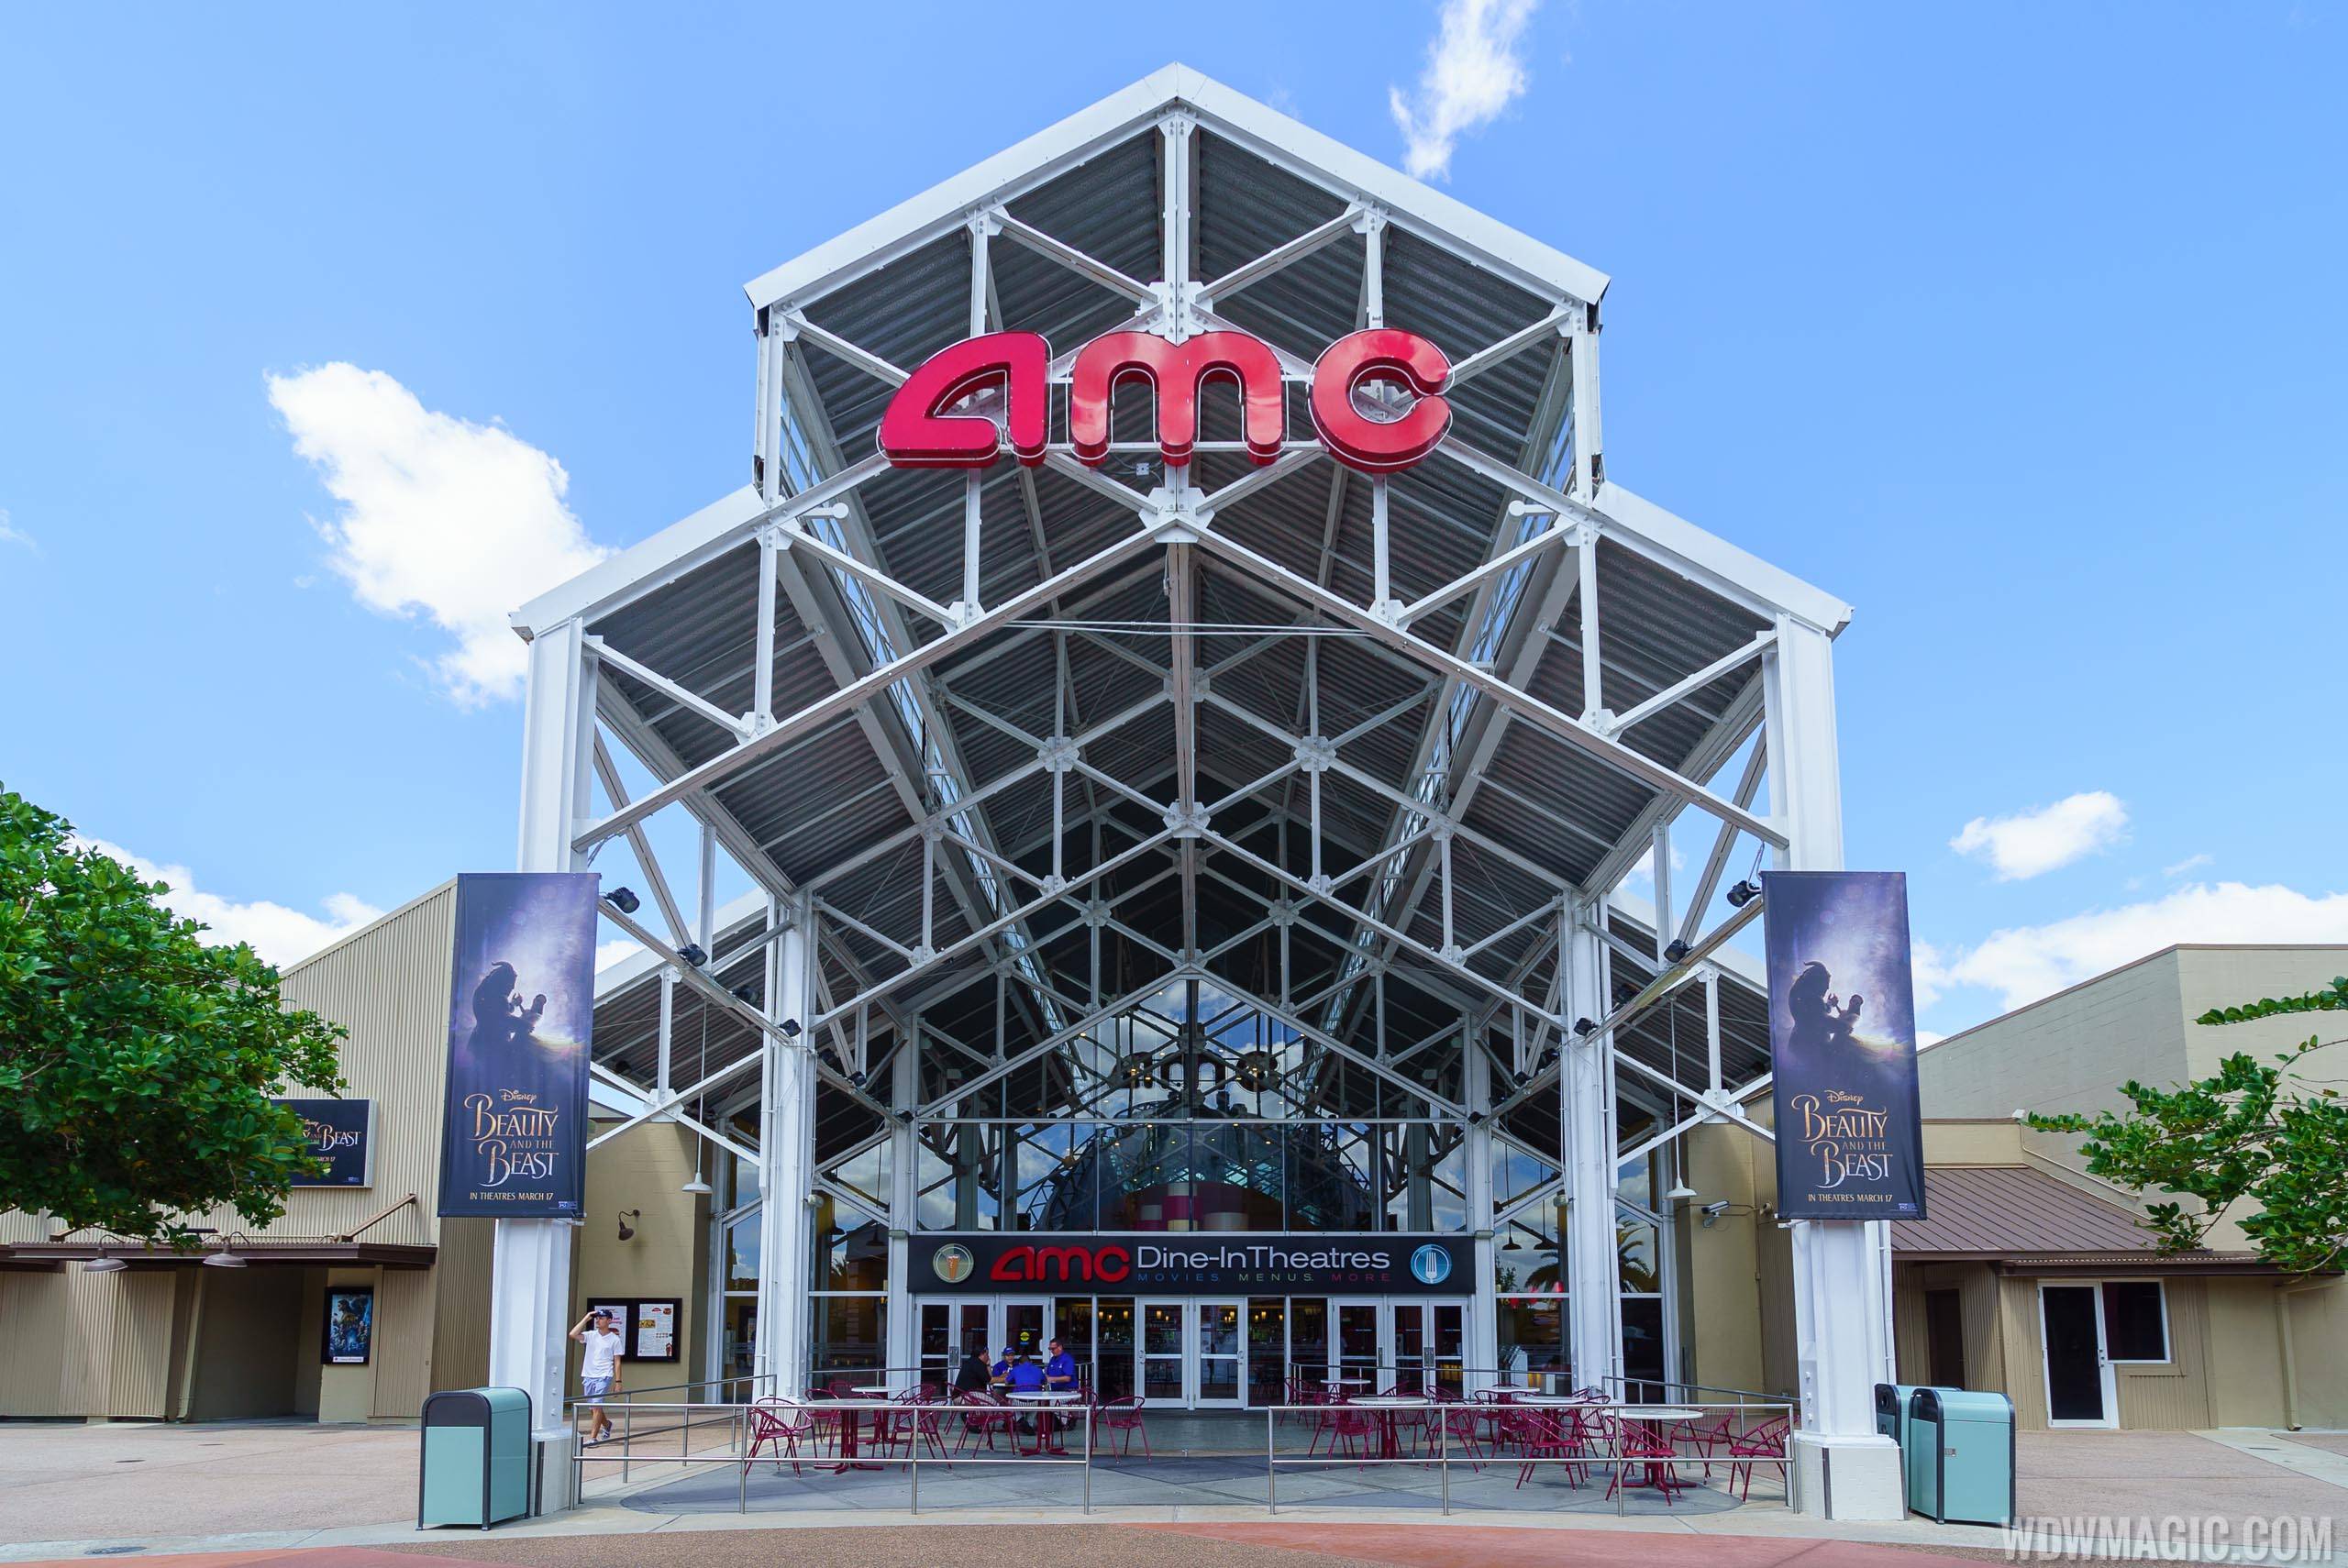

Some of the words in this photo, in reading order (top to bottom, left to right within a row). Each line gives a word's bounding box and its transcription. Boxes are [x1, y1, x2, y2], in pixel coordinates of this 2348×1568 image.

[876, 327, 1454, 472] amc
[499, 1089, 537, 1103] Disney
[1824, 1089, 1864, 1105] Disney
[464, 1093, 559, 1141] BEAUTY
[1791, 1094, 1888, 1143] BEAUTY
[317, 1124, 361, 1152] BEAST
[510, 1141, 532, 1149] AND
[536, 1141, 554, 1149] THE
[1842, 1142, 1864, 1150] AND
[1868, 1142, 1886, 1150] THE
[478, 1140, 559, 1187] BEAST
[1811, 1141, 1893, 1188] BEAST
[470, 1192, 478, 1200] IN
[481, 1192, 515, 1200] THEATRES
[518, 1192, 544, 1200] MARCH
[546, 1192, 554, 1200] 17
[1808, 1194, 1816, 1202] IN
[1819, 1194, 1855, 1202] THEATRES
[1856, 1194, 1883, 1202] MARCH
[1885, 1194, 1893, 1202] 17
[991, 1246, 1130, 1282] amc
